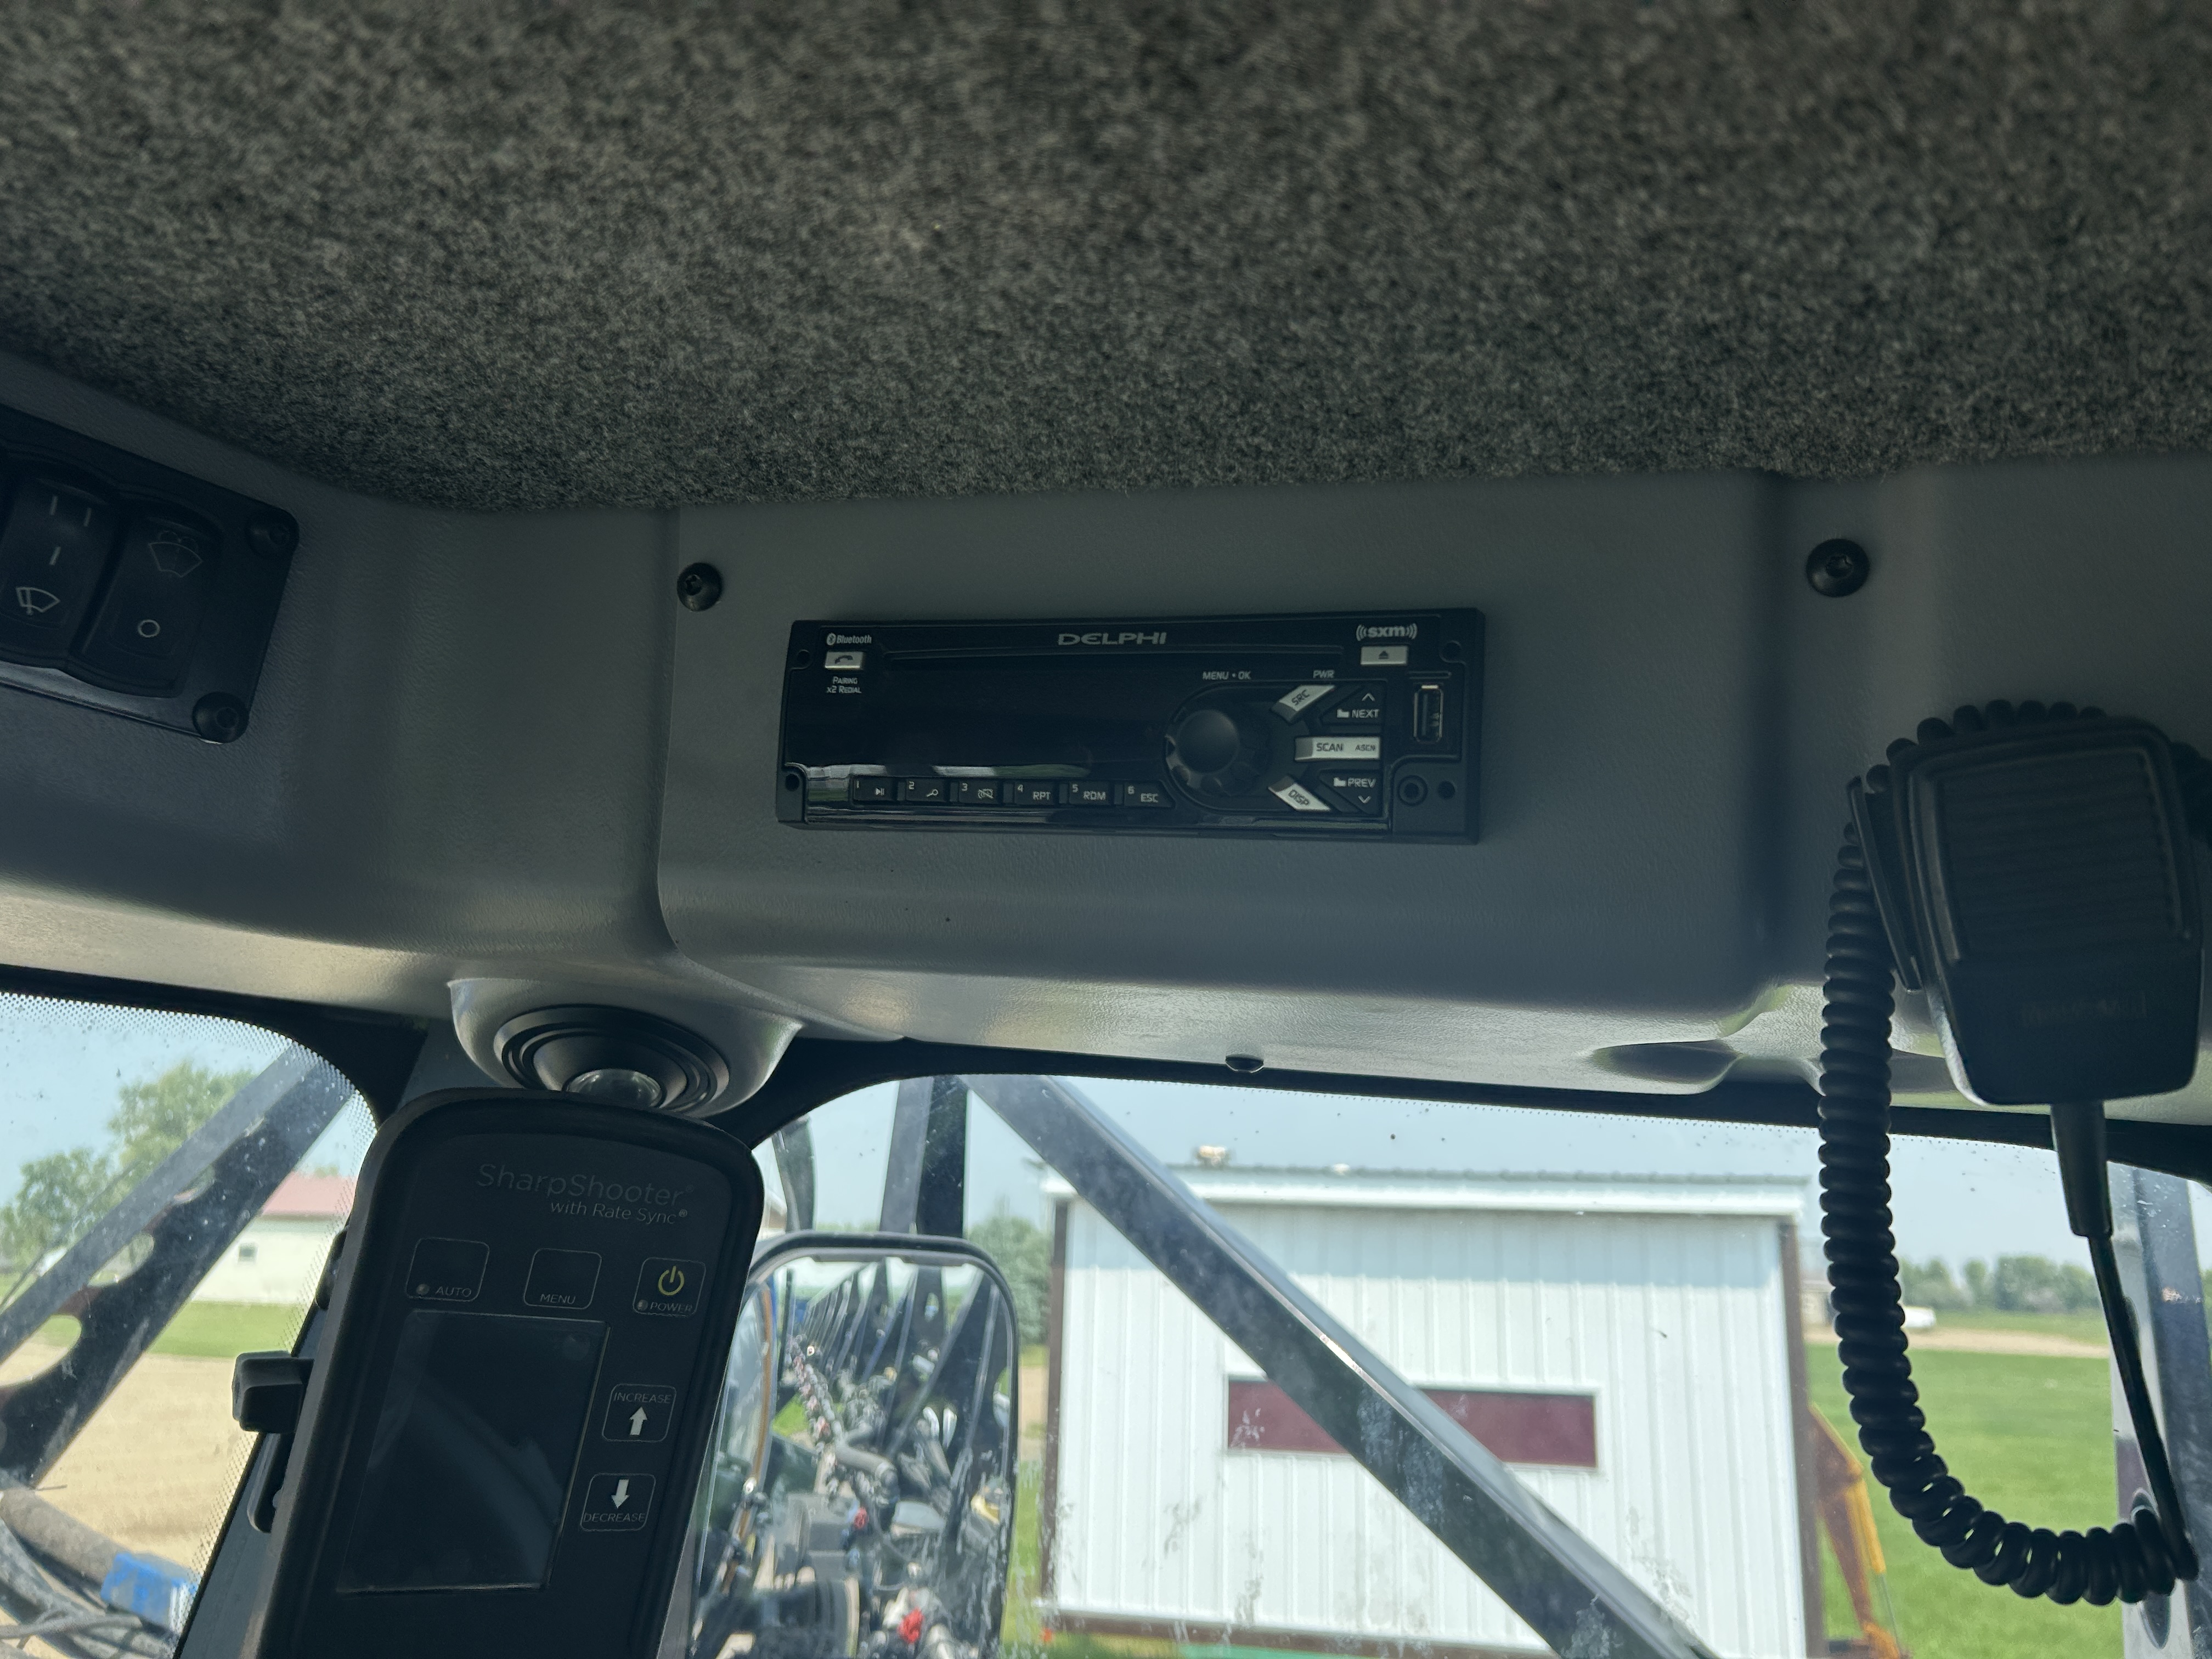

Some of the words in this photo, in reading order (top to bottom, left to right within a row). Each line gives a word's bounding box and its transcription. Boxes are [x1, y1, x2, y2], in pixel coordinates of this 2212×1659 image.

[836, 634, 872, 644] Bluetooth
[1058, 633, 1167, 646] DELPHI
[1203, 672, 1229, 680] MENU
[1238, 671, 1252, 680] OK
[1313, 670, 1335, 679] PWR
[1291, 689, 1311, 706] SRC
[1352, 709, 1379, 719] NEXT
[1316, 742, 1344, 753] SCAN
[909, 781, 915, 789] 2
[962, 782, 968, 792] 3
[1347, 777, 1376, 788] PREV
[1017, 783, 1023, 792] 4
[1033, 791, 1052, 800] RPT
[1073, 784, 1079, 793] 5
[1084, 791, 1106, 800] RDM
[1128, 786, 1135, 794] 6
[1141, 793, 1159, 803] ESC
[1288, 789, 1311, 807] DISP
[550, 1200, 586, 1216] with
[592, 1203, 631, 1220] Rate
[436, 1285, 472, 1297] AUTO
[540, 1293, 576, 1305] MENU
[650, 1301, 693, 1313] POWER
[613, 1391, 672, 1405] INCREASE
[583, 1511, 645, 1524] DECREASE
